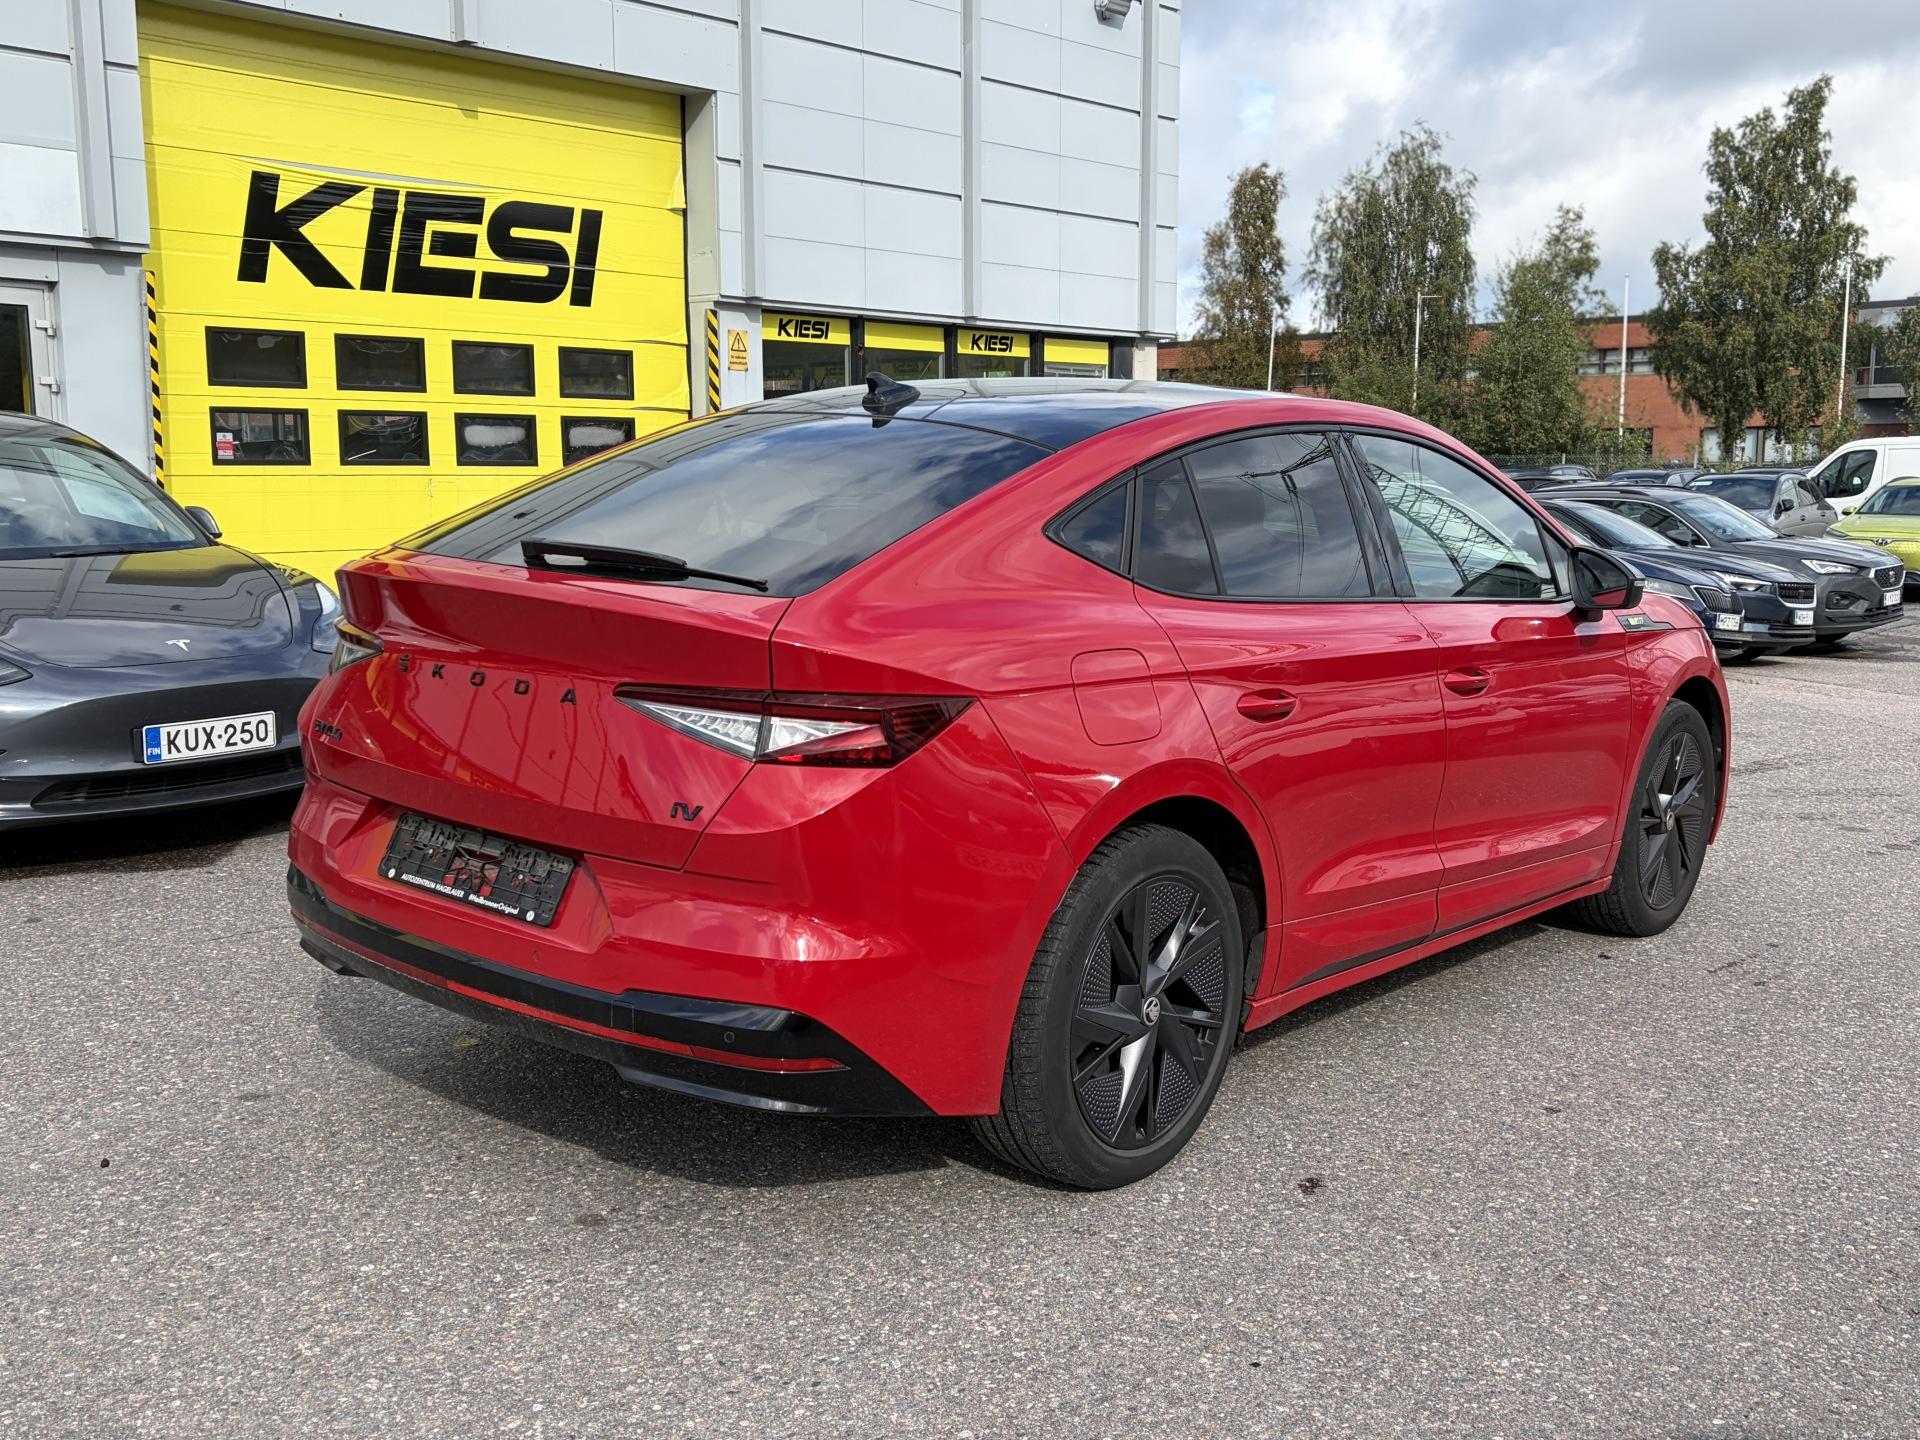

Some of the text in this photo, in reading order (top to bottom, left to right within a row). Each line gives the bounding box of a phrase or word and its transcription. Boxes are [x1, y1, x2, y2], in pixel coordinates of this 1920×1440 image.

[237, 170, 604, 307] KIESI
[778, 318, 830, 340] KIESI
[971, 333, 1014, 353] KIESI
[147, 719, 269, 756] FIN KUX-250
[400, 873, 436, 889] AUTOZENTRUM
[435, 882, 465, 898] HAGELAUER
